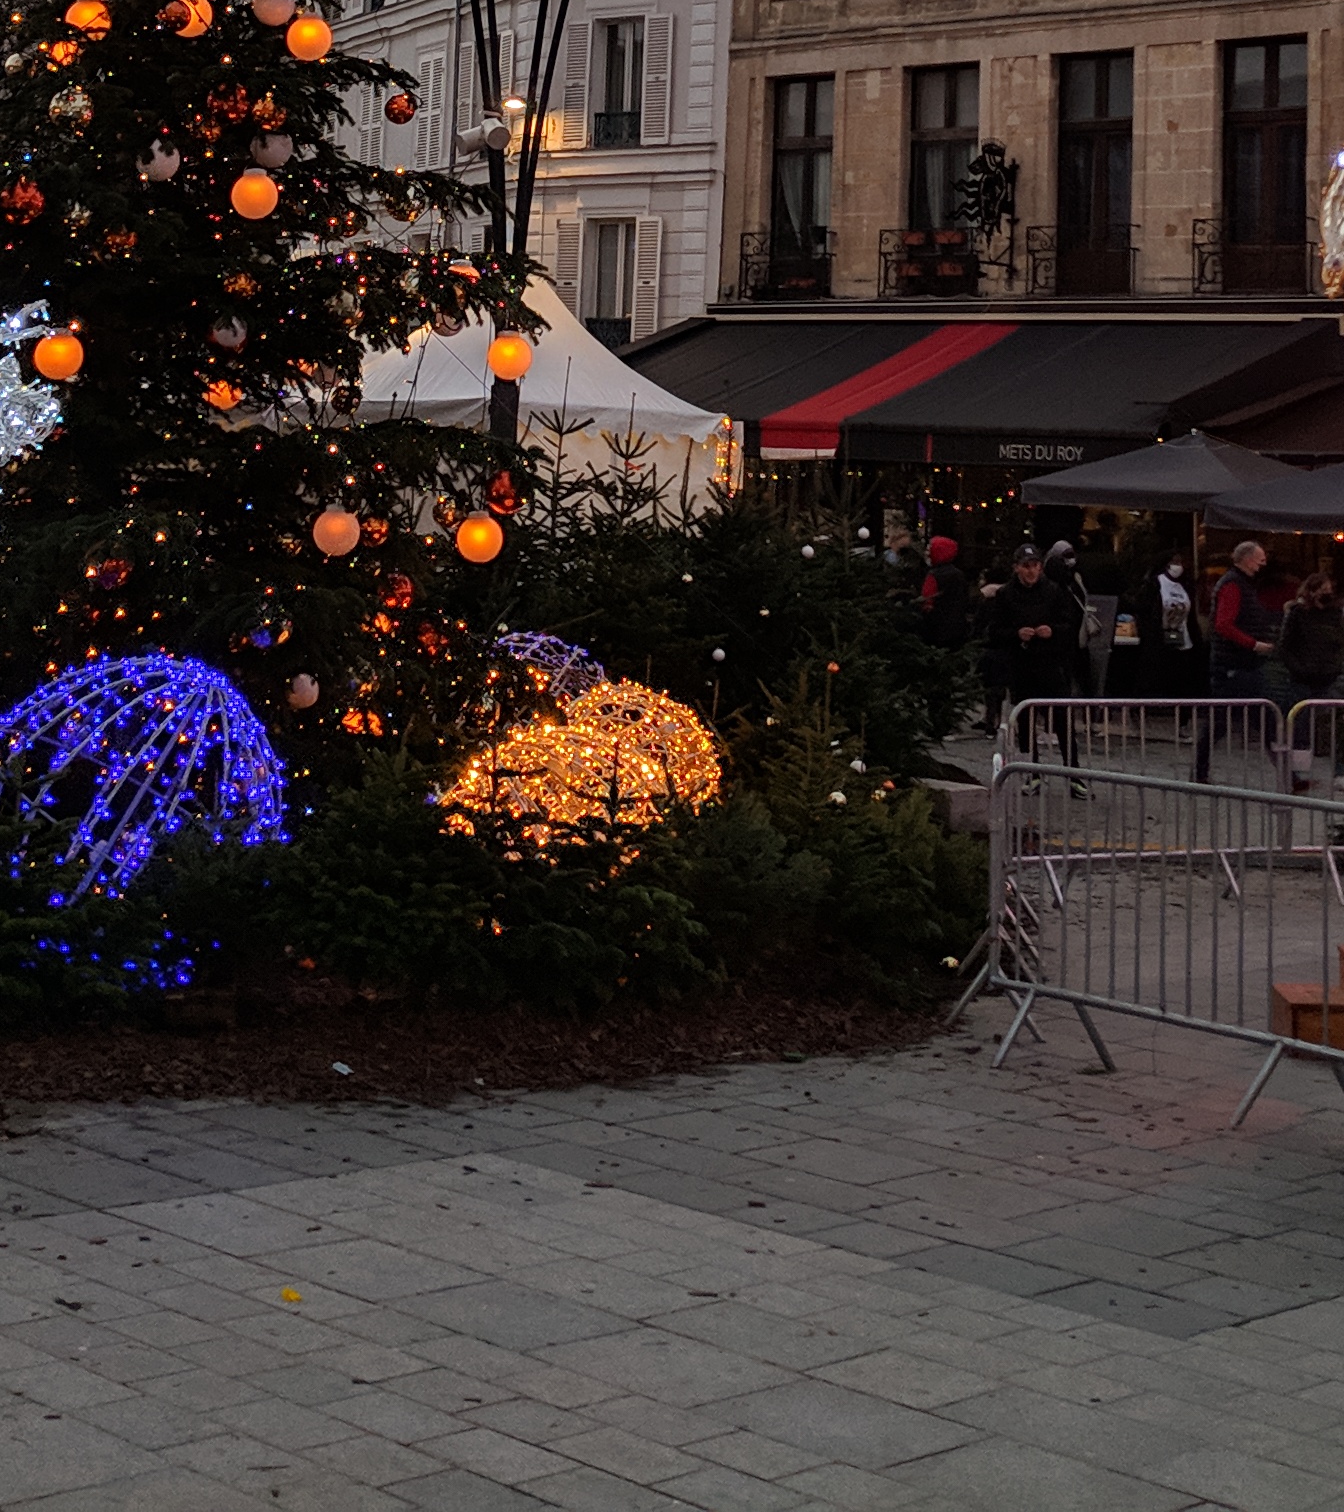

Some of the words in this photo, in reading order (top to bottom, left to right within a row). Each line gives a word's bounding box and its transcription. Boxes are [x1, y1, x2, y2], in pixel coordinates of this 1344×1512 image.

[998, 443, 1033, 461] METS
[1035, 444, 1054, 461] DU
[1056, 445, 1085, 462] ROY
